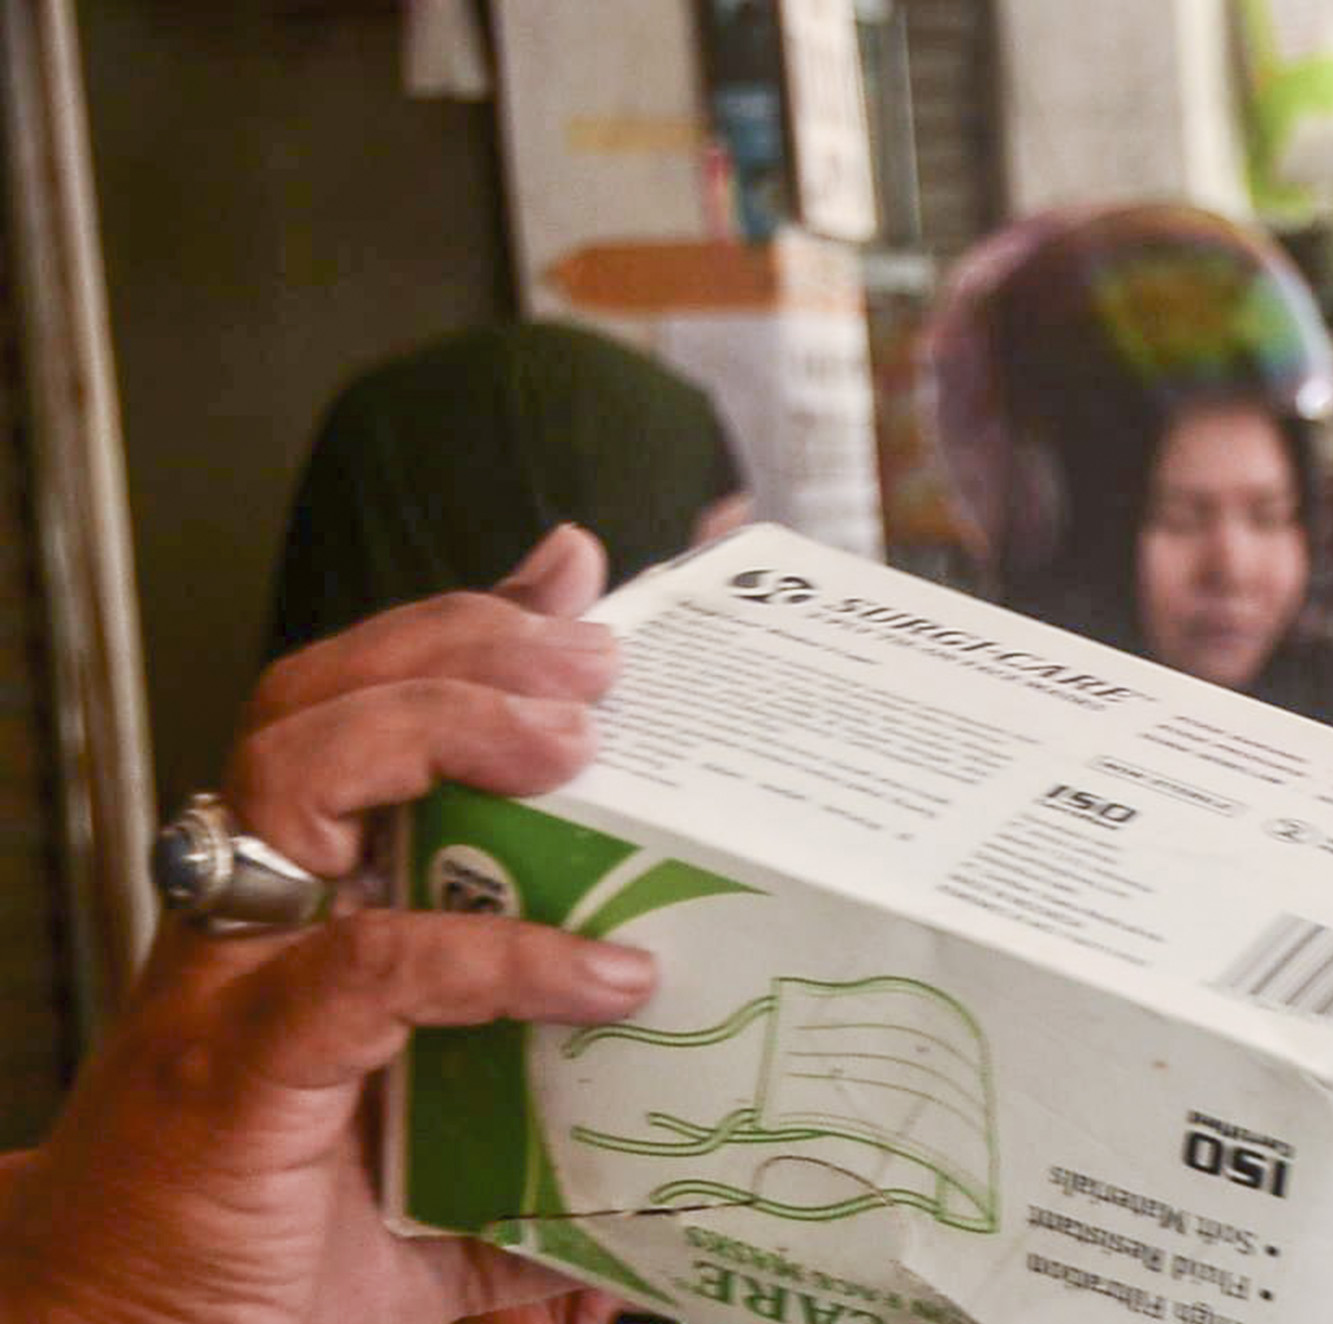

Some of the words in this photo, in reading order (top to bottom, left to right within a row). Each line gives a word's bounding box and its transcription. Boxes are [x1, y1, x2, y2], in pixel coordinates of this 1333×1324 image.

[1043, 784, 1141, 825] ISO
[1182, 1130, 1289, 1200] ISO
[1048, 1166, 1188, 1235] Materials
[1027, 1205, 1167, 1274] Resistant
[1195, 1216, 1258, 1256] Soft
[1027, 1253, 1167, 1320] Filtration
[1171, 1255, 1250, 1301] Fluid
